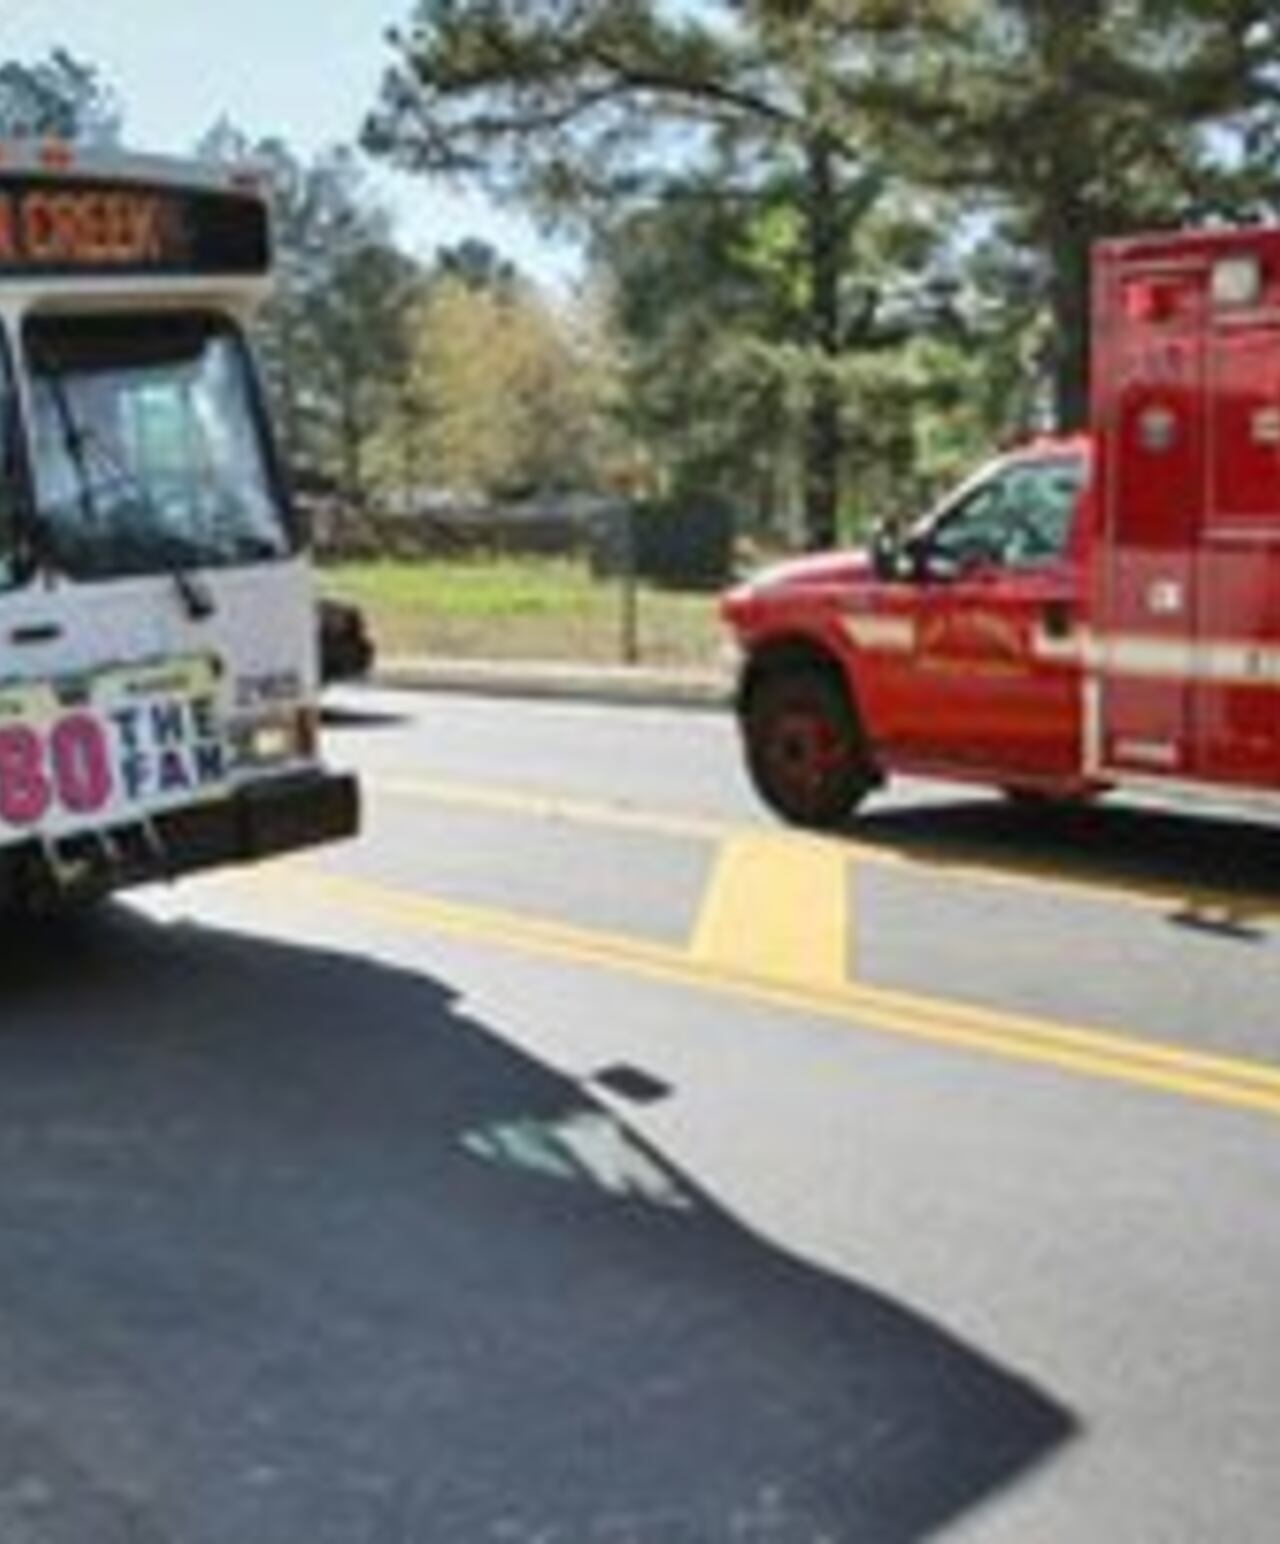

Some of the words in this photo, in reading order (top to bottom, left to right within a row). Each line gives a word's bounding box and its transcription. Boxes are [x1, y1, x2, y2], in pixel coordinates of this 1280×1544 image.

[23, 192, 162, 260] CREEK
[113, 695, 215, 748] THE
[123, 744, 224, 801] FAN
